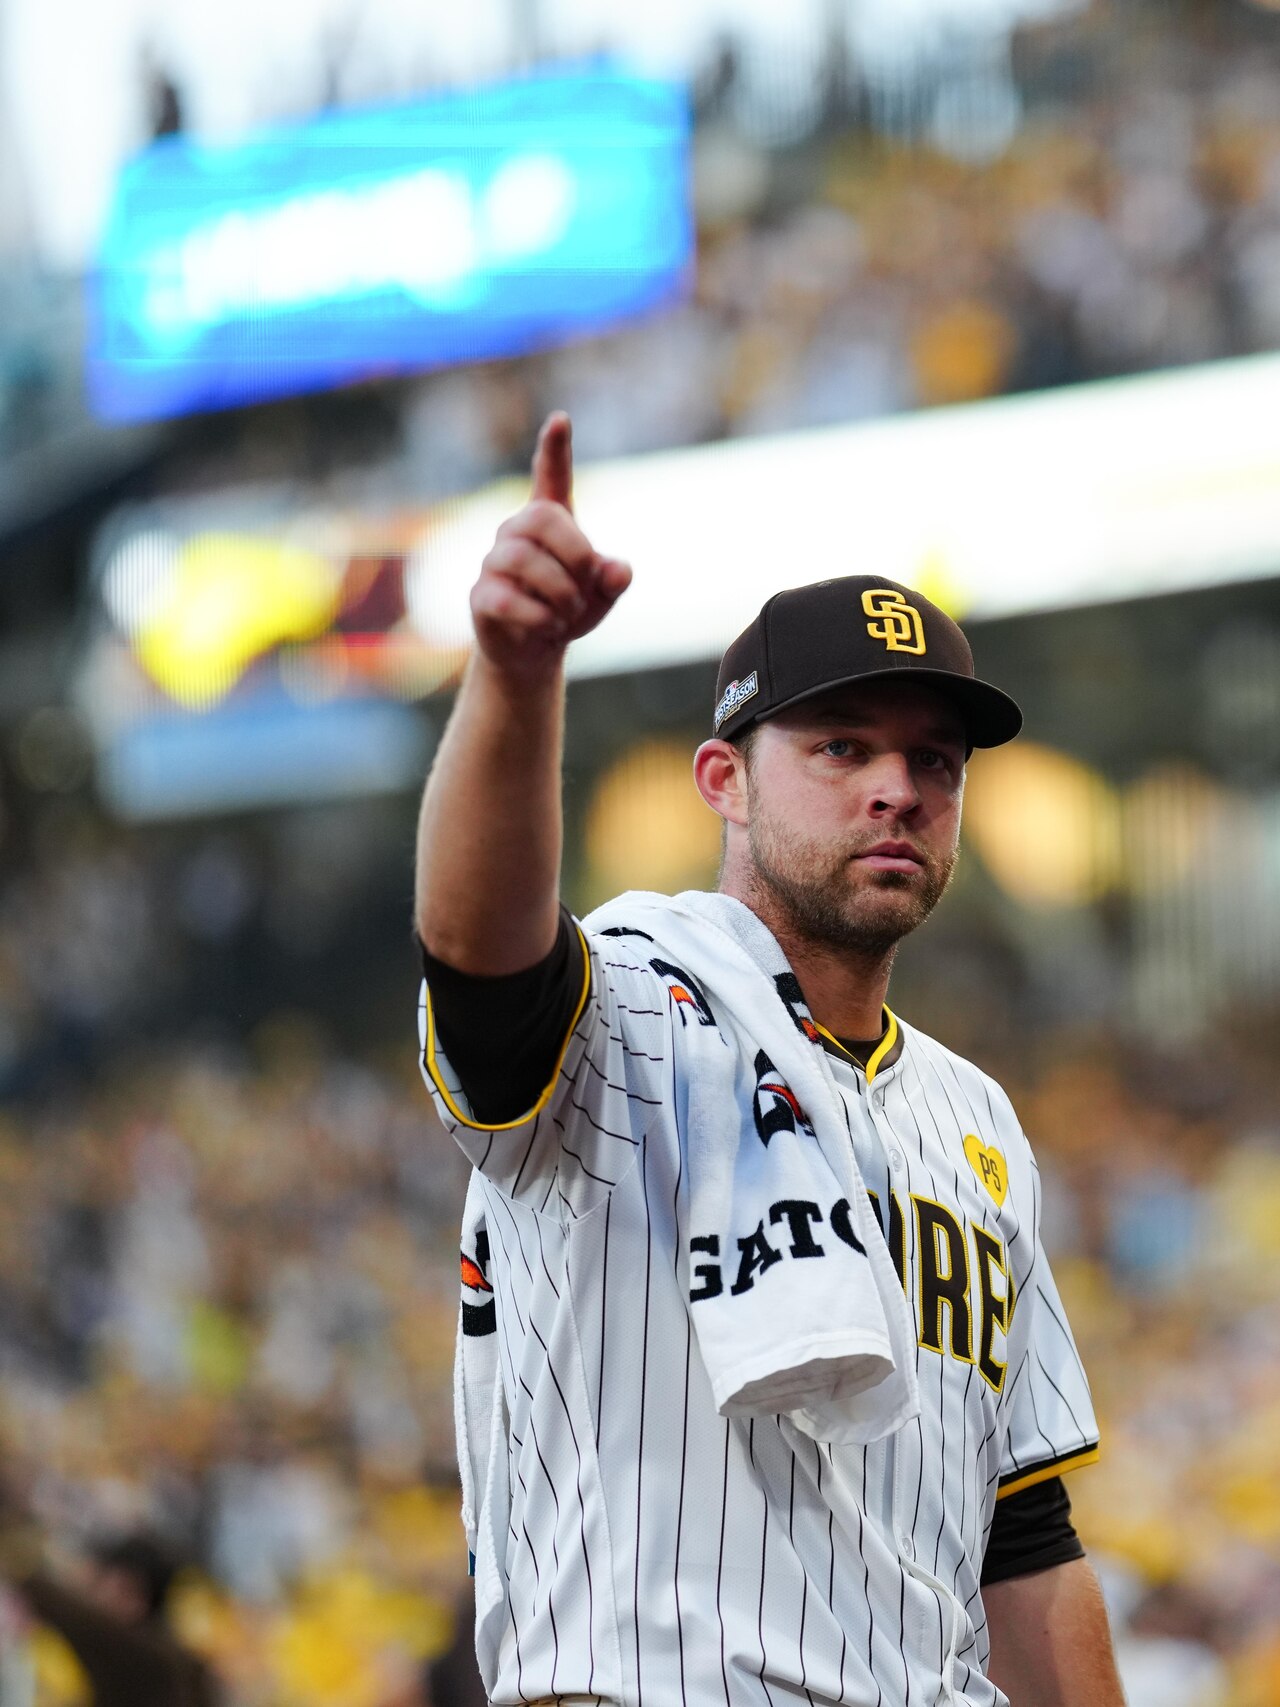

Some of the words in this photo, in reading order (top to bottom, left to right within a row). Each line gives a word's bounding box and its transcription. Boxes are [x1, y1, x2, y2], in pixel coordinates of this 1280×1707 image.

[861, 589, 926, 655] SD
[715, 676, 756, 725] STSEASON
[978, 1151, 1002, 1193] PS
[866, 1187, 1016, 1393] RE
